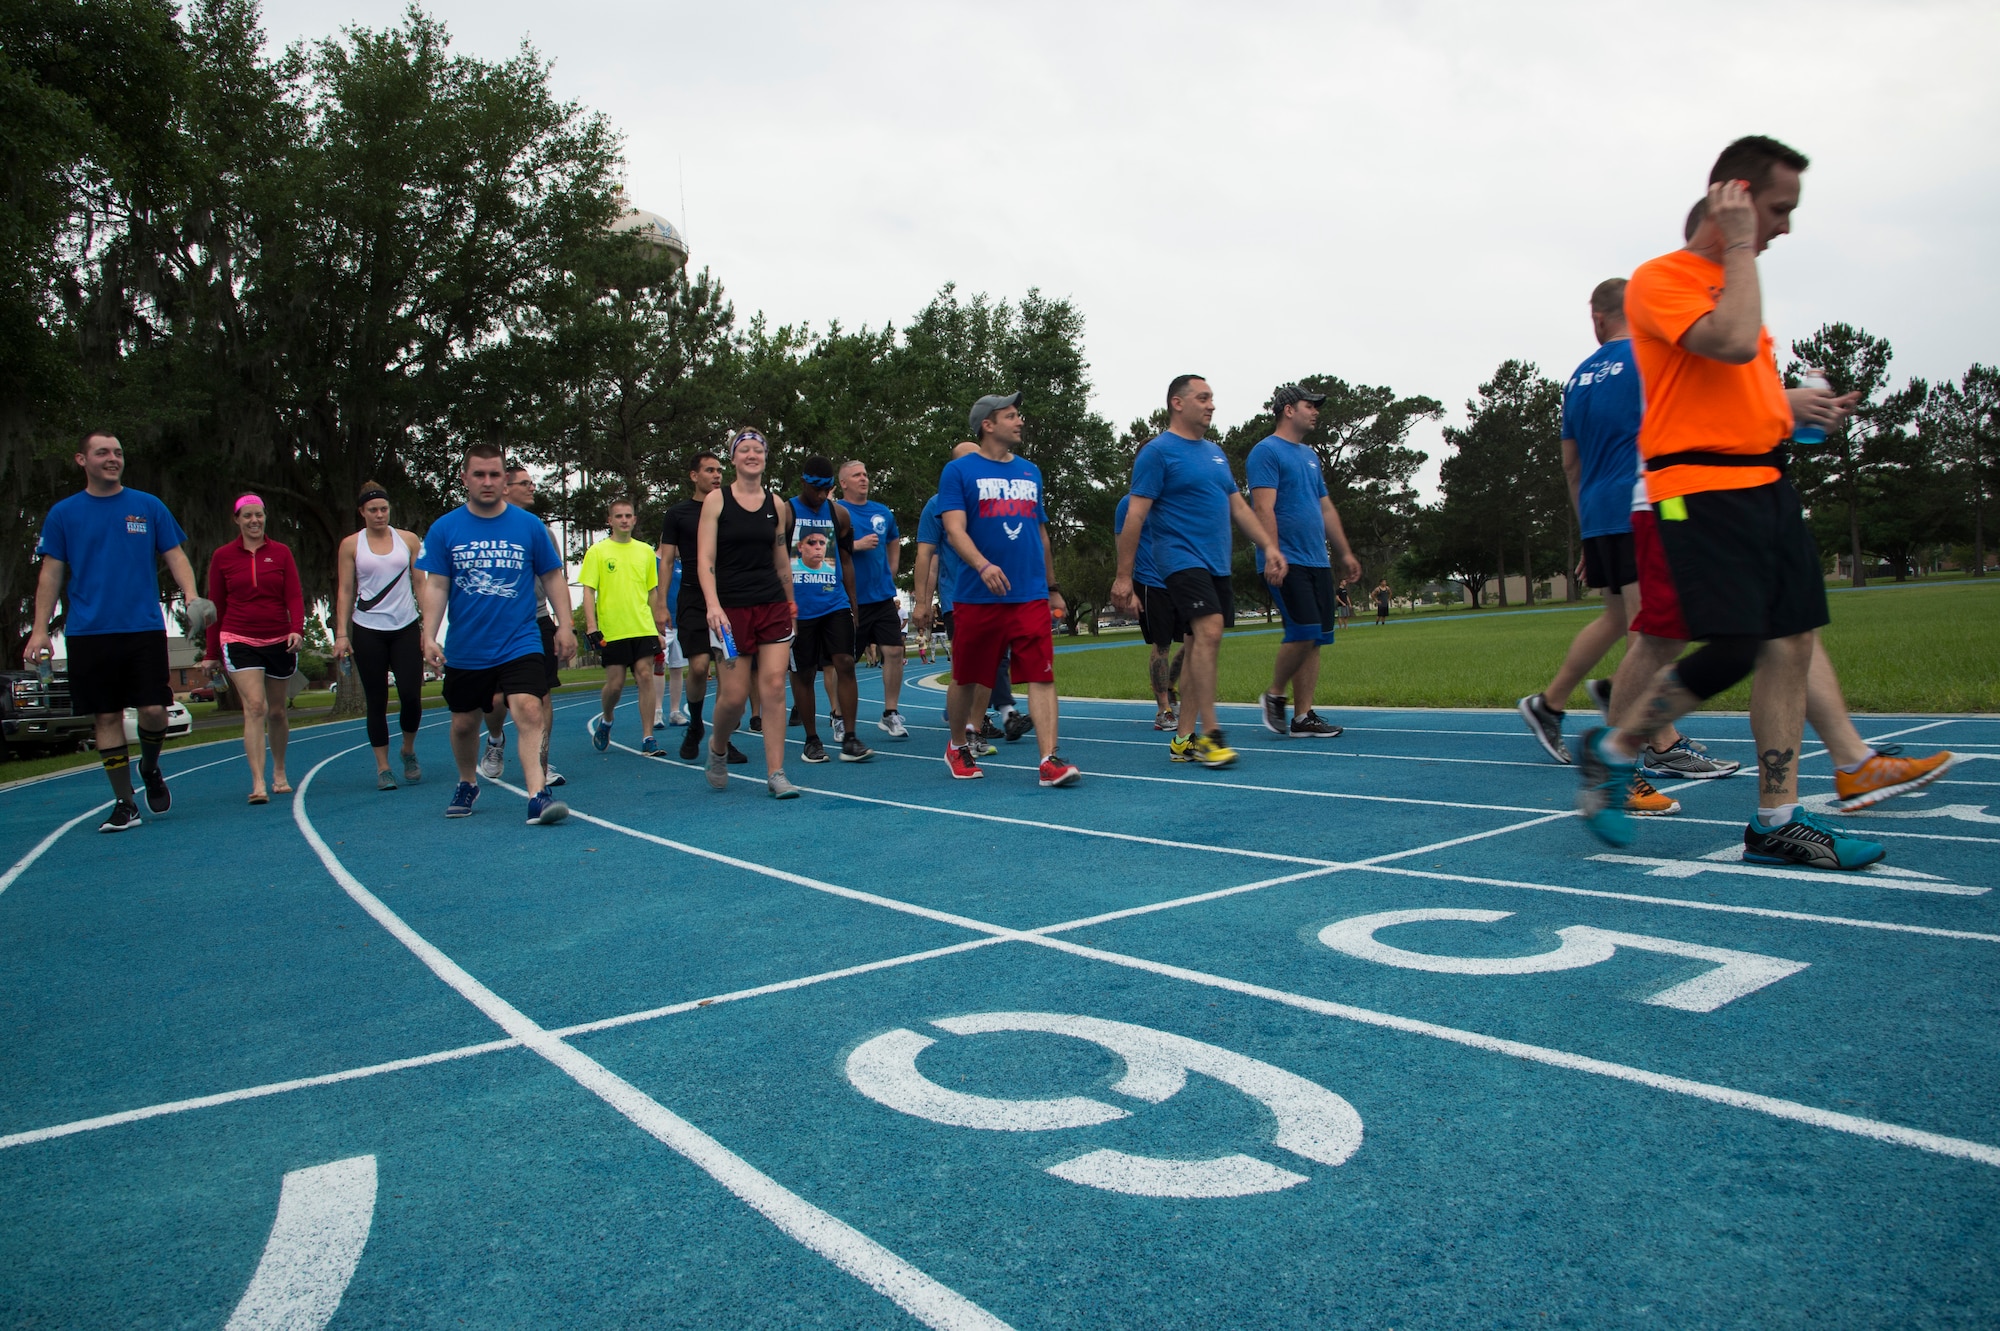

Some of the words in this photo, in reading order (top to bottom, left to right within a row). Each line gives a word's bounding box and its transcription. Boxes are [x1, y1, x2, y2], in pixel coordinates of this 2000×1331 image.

[979, 487, 1000, 500] AIR
[1003, 486, 1037, 502] FORC
[795, 518, 811, 527] OU'RE
[812, 519, 834, 528] KILLIN
[470, 540, 508, 550] 2015
[452, 551, 476, 561] 2ND
[478, 550, 524, 561] ANNUAL
[453, 559, 492, 570] TIGER
[496, 559, 524, 570] RUN
[804, 574, 836, 585] SMALLS
[1318, 908, 1810, 1014] 5
